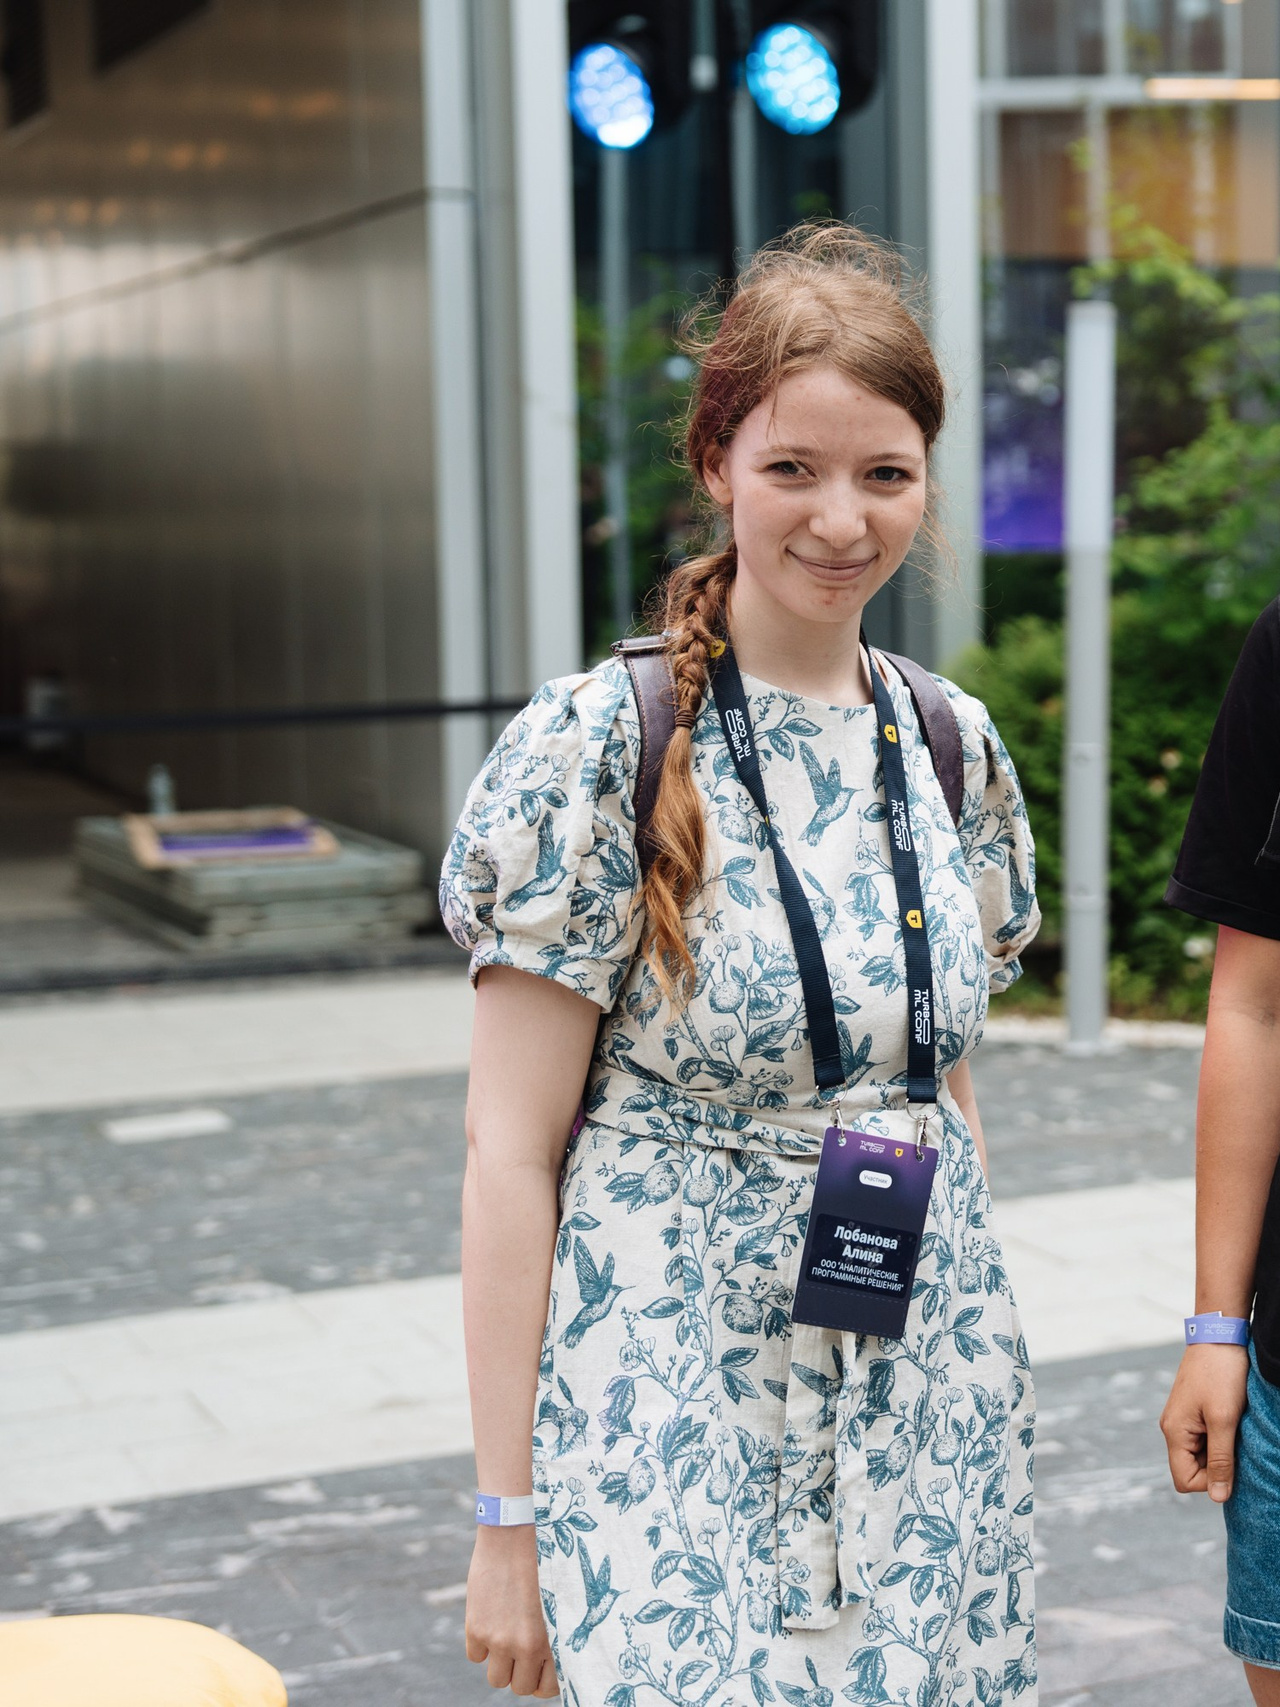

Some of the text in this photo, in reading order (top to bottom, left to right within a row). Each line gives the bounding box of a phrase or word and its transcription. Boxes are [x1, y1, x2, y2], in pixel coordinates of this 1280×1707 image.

[725, 709, 745, 762] TURBO
[733, 708, 752, 757] ML CONF
[891, 799, 903, 851] ML CONF
[897, 800, 911, 852] TURBO
[913, 989, 923, 1045] ML CONF
[921, 989, 930, 1045] TURBO
[863, 1173, 888, 1185] Участник
[834, 1225, 898, 1250] Лобанова
[842, 1245, 884, 1264] Алина
[811, 1267, 904, 1292] ПРОГРАММНЫЕ РЕШЕНИЯ"
[820, 1259, 900, 1282] ООО "АНАЛИТИЧЕСКИЕ
